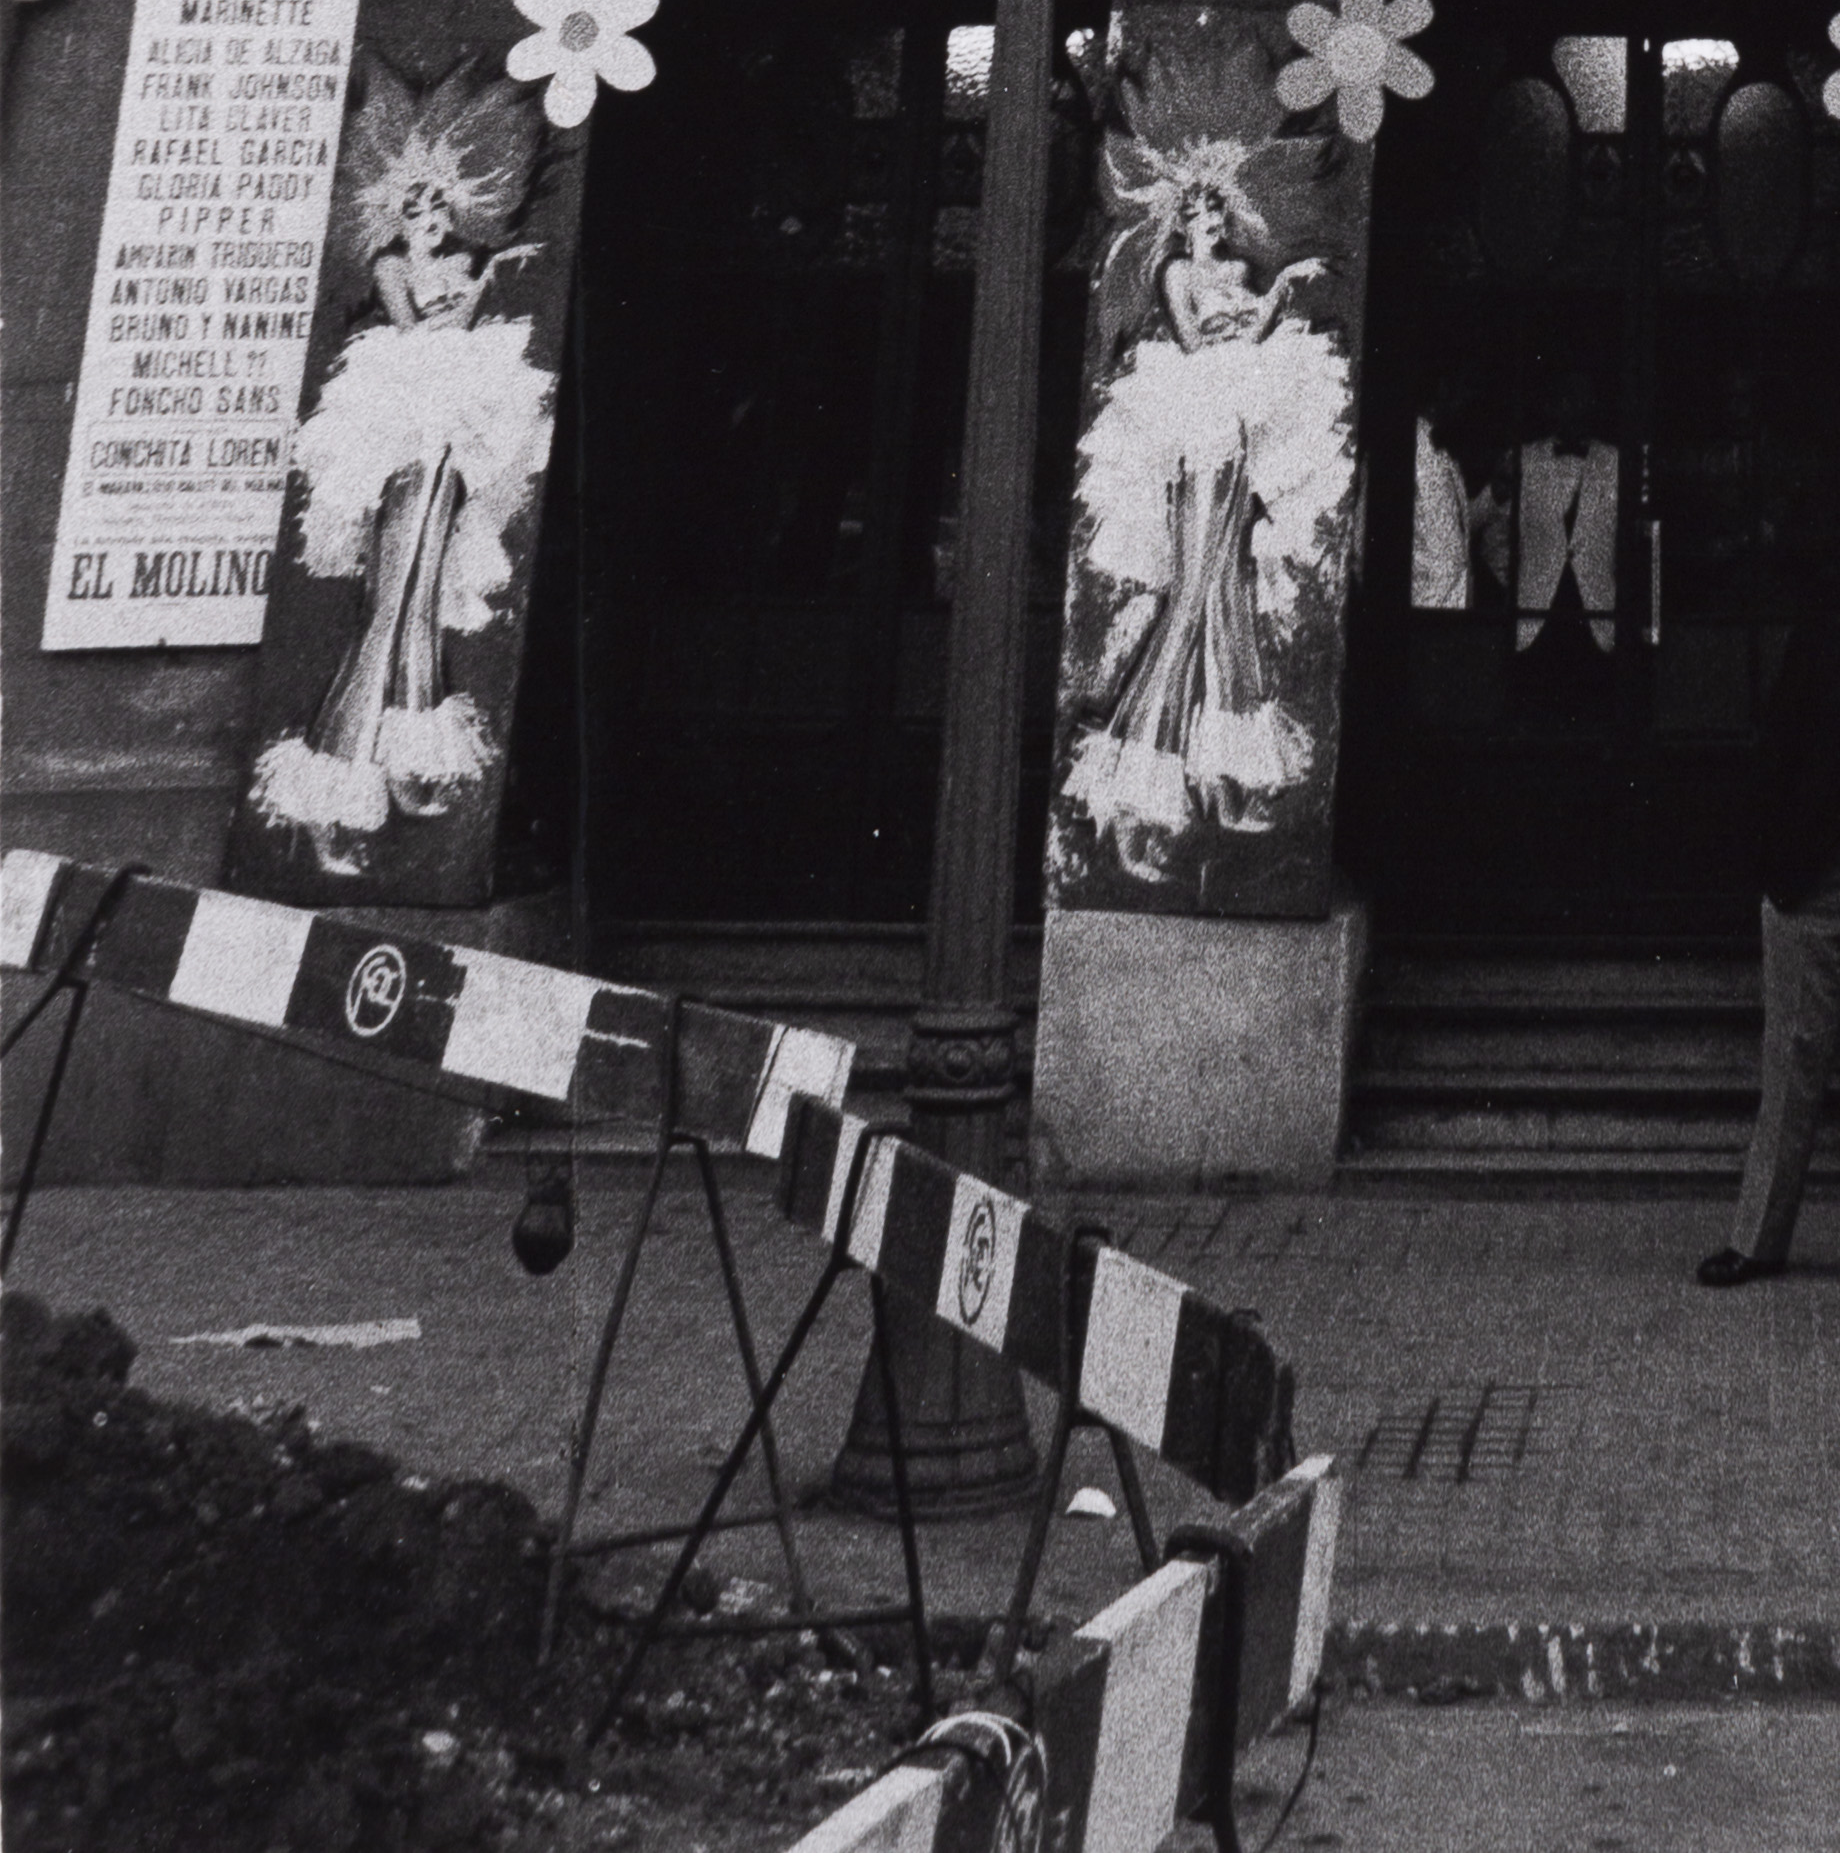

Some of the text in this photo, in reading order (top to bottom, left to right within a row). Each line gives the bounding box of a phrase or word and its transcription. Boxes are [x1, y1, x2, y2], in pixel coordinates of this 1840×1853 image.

[147, 38, 341, 66] ALICIA DE ALZAGA
[140, 73, 338, 101] FRANK JOHNSON
[131, 138, 328, 166] RAFAEL GARCIA
[137, 173, 222, 201] GLORIA
[157, 206, 276, 235] PIPPER
[109, 276, 310, 306] ANTONIO VARGAS
[109, 311, 312, 342] BRUNO Y NANINE
[132, 350, 238, 379] MICHELL
[107, 385, 280, 416] FONCHO SANS
[90, 437, 280, 469] CONCHITA LOREN
[68, 550, 275, 600] EL MOLINO
